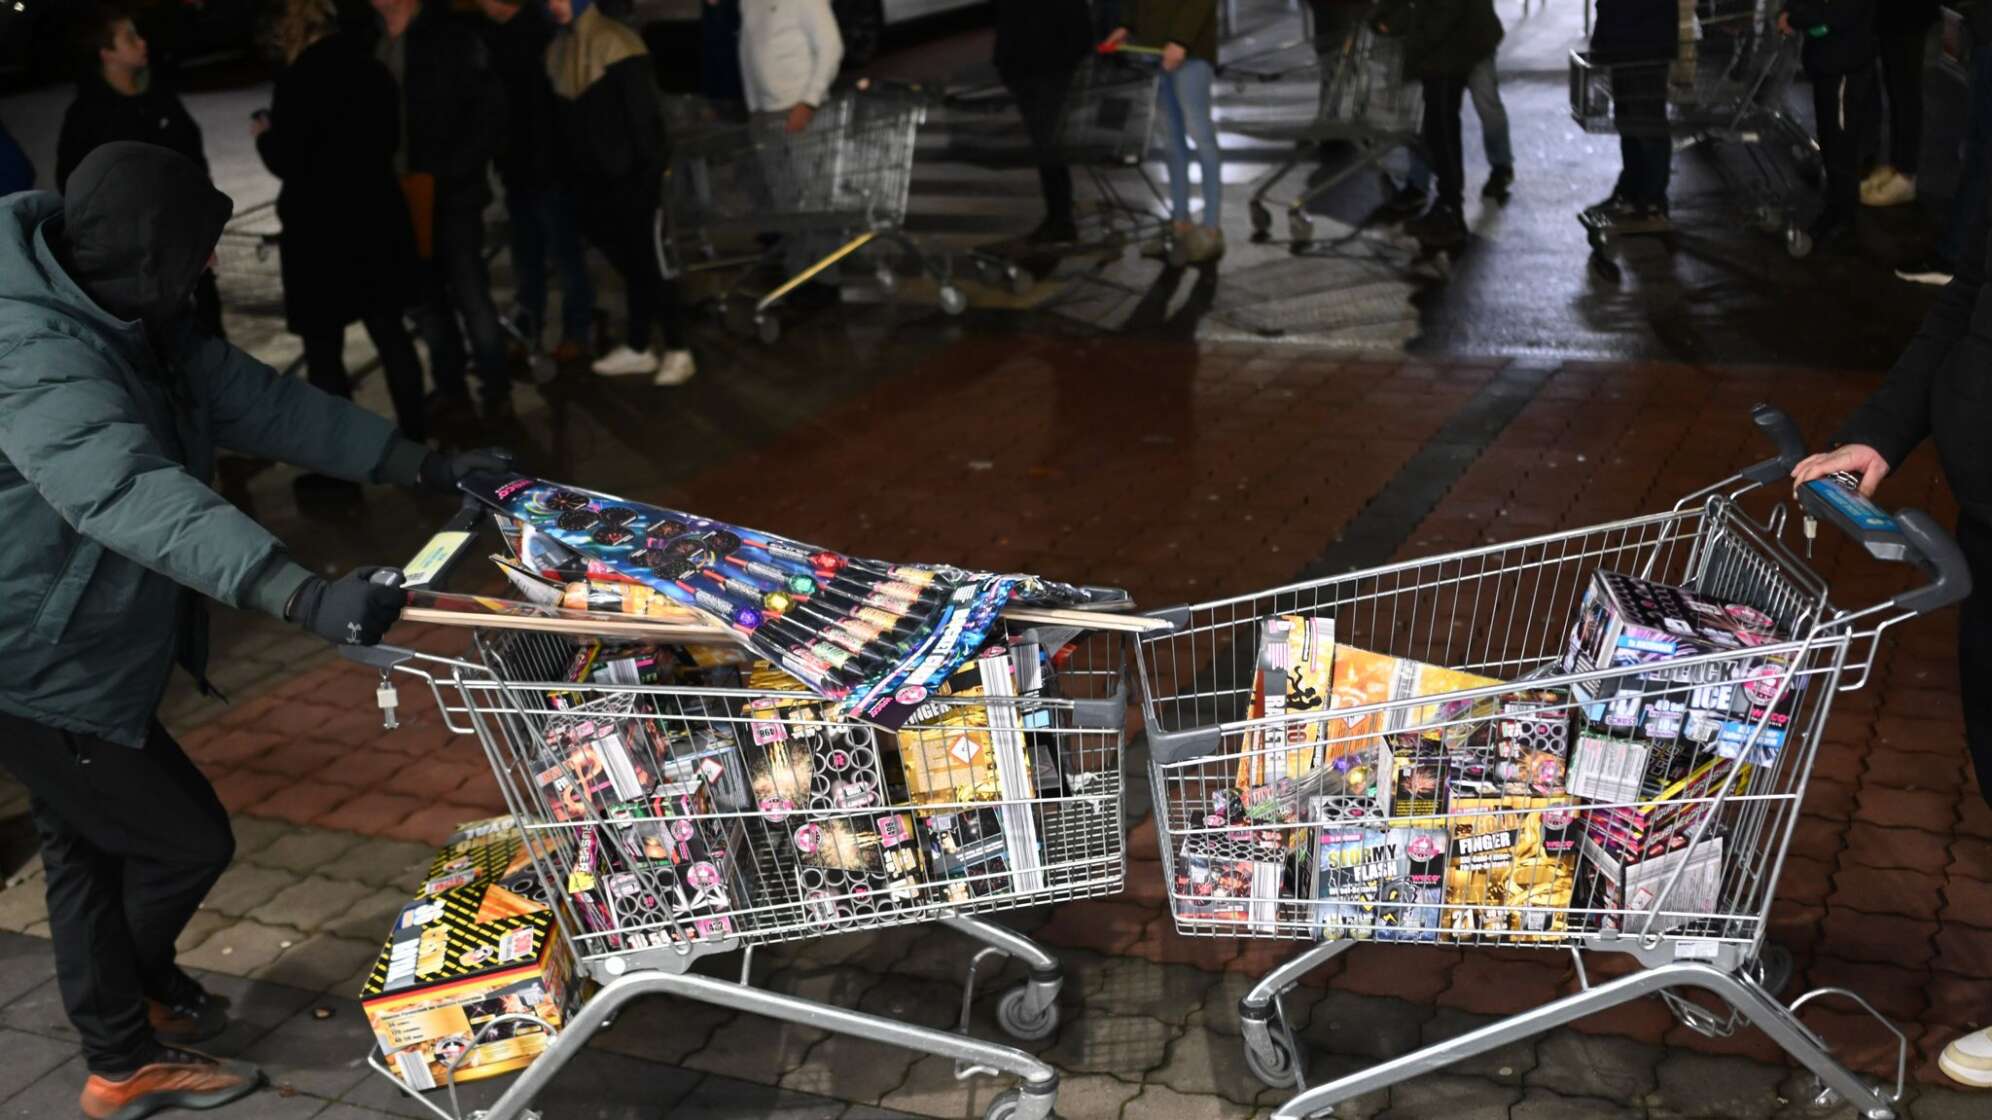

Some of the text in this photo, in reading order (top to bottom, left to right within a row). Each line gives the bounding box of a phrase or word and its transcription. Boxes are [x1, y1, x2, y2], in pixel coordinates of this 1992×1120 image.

[1691, 686, 1734, 709] ICE
[905, 702, 951, 726] INGER
[1751, 709, 1788, 722] WCO
[1459, 831, 1511, 854] FINGER
[1328, 843, 1396, 869] STORMY
[1353, 861, 1398, 881] FLASH
